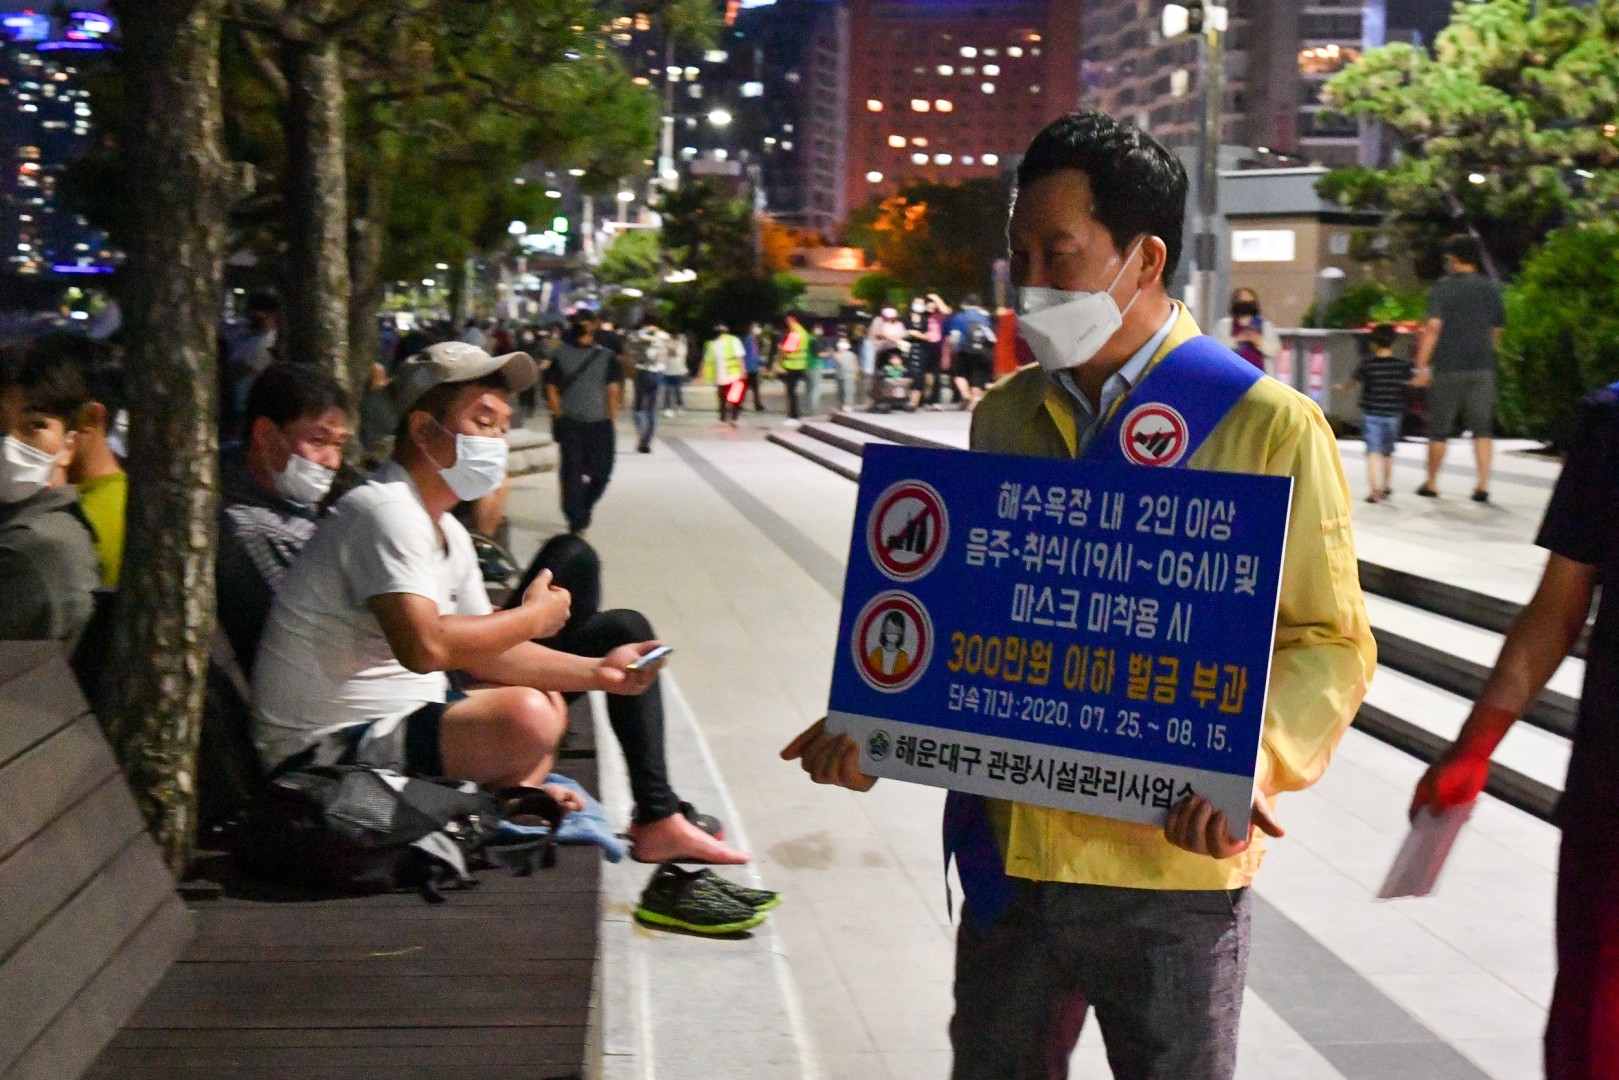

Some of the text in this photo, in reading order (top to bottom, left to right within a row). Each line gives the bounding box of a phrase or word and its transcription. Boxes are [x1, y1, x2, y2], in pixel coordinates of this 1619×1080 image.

[998, 481, 1236, 541] 해수욕장 내 2인 이상
[1234, 554, 1259, 597] 및
[1011, 583, 1192, 643] 마스크 미착용 시
[947, 631, 1247, 714] 300만원 이하 벌금 부과
[895, 735, 981, 775] 해운대구
[1080, 704, 1109, 734] 07.
[1166, 717, 1196, 747] 08.
[1206, 722, 1232, 753] 15.
